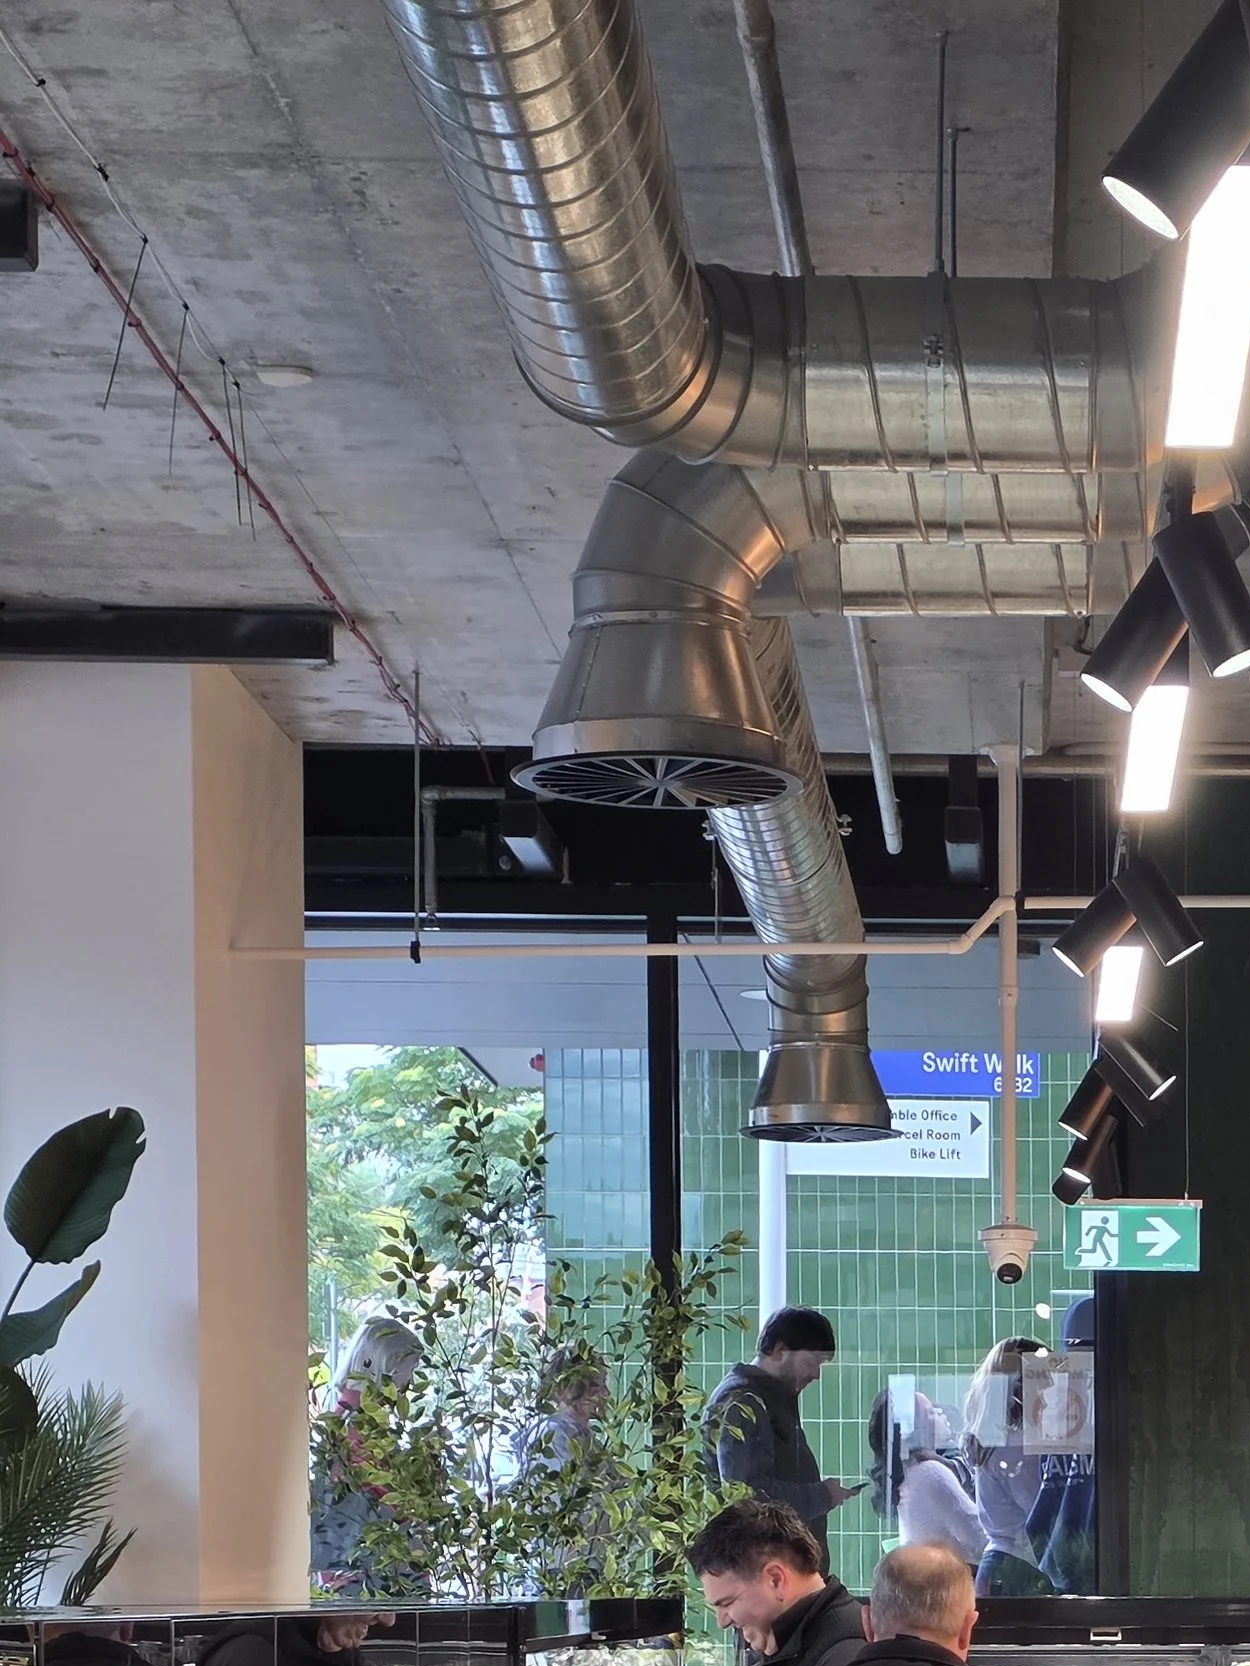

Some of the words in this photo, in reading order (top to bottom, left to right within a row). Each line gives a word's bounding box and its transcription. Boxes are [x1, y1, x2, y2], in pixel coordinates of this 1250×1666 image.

[922, 1051, 979, 1073] Swift
[983, 1053, 1035, 1075] Wlk
[993, 1077, 1033, 1093] 632
[921, 1109, 958, 1121] Office
[899, 1128, 923, 1140] rcel
[926, 1129, 961, 1141] Room
[910, 1147, 936, 1160] Bike
[939, 1148, 961, 1160] Lift
